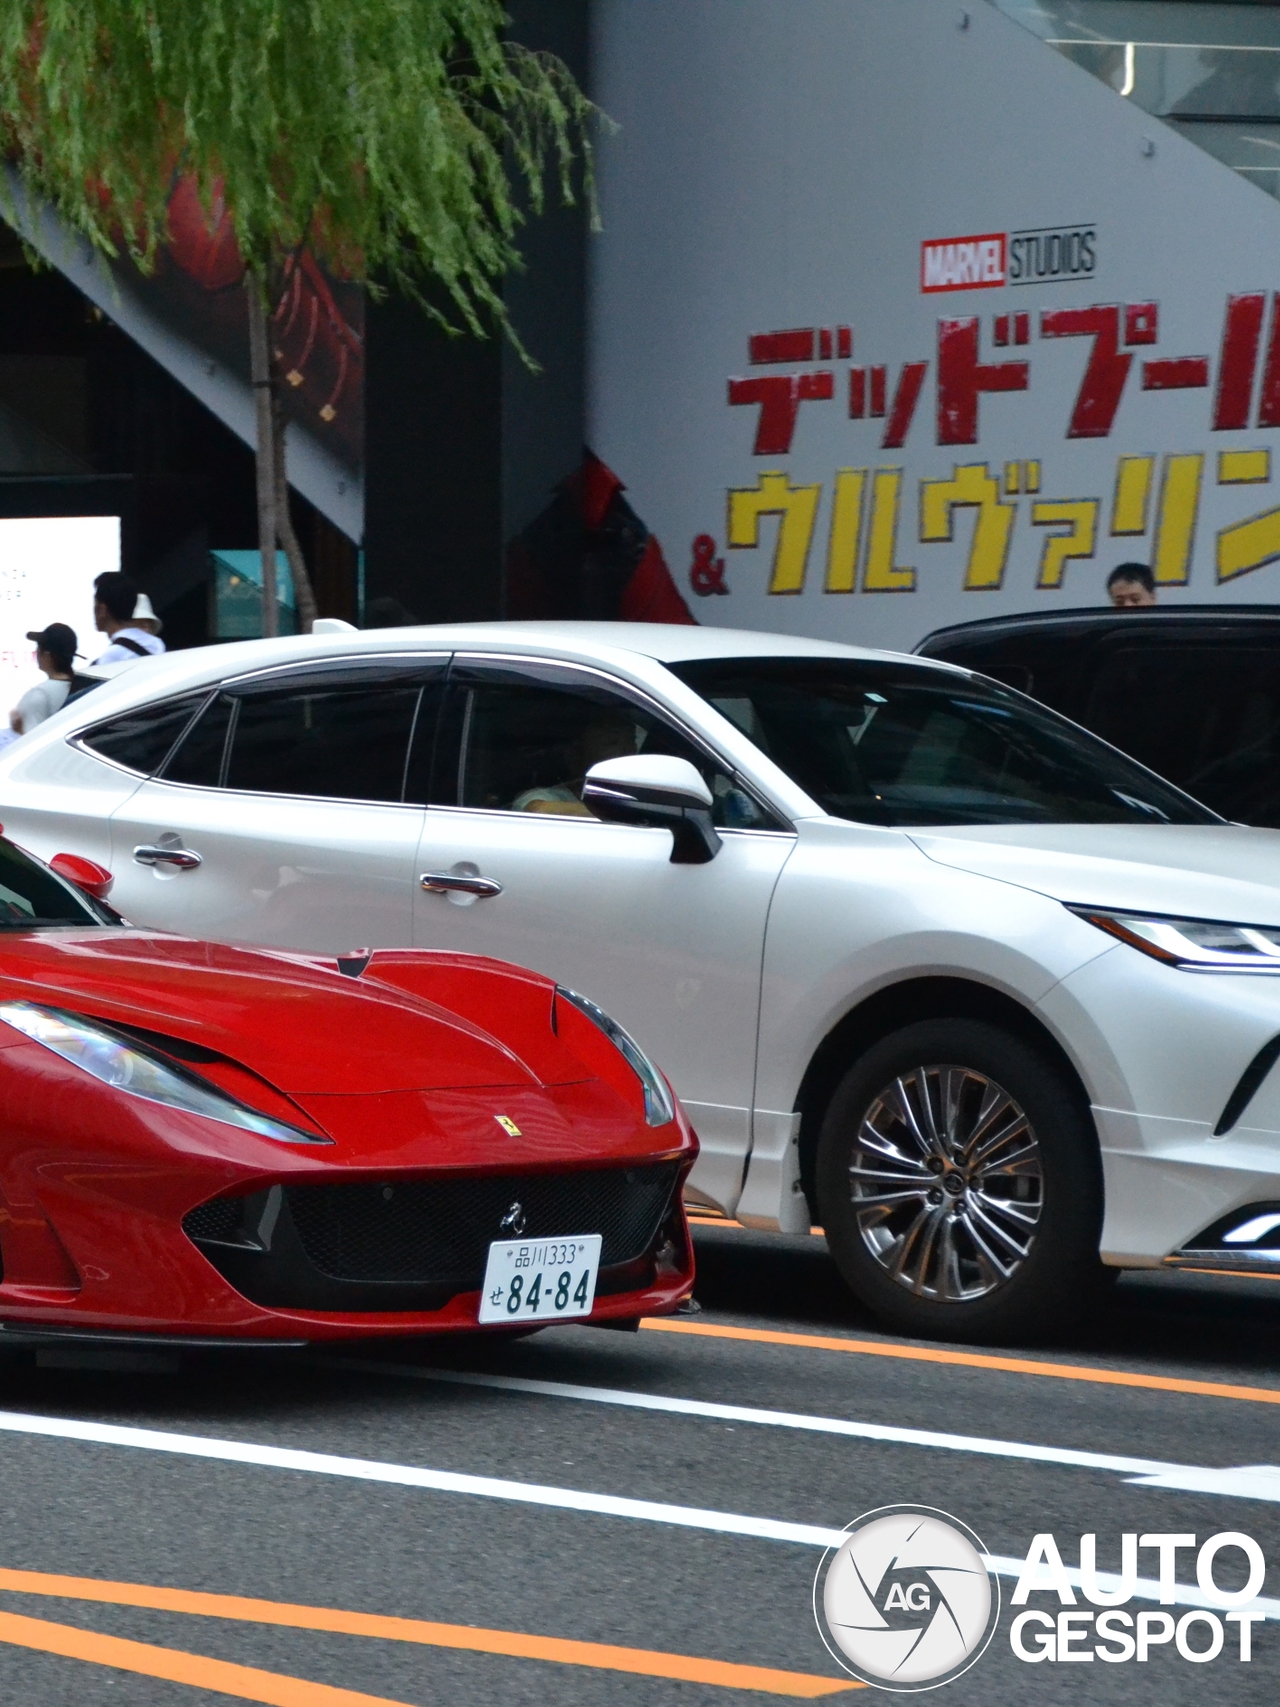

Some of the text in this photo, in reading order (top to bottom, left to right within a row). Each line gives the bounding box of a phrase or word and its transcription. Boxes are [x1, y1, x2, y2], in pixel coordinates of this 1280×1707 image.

[923, 231, 1097, 289] MARVEL STUDIOS
[490, 1269, 590, 1314] せ 84-84
